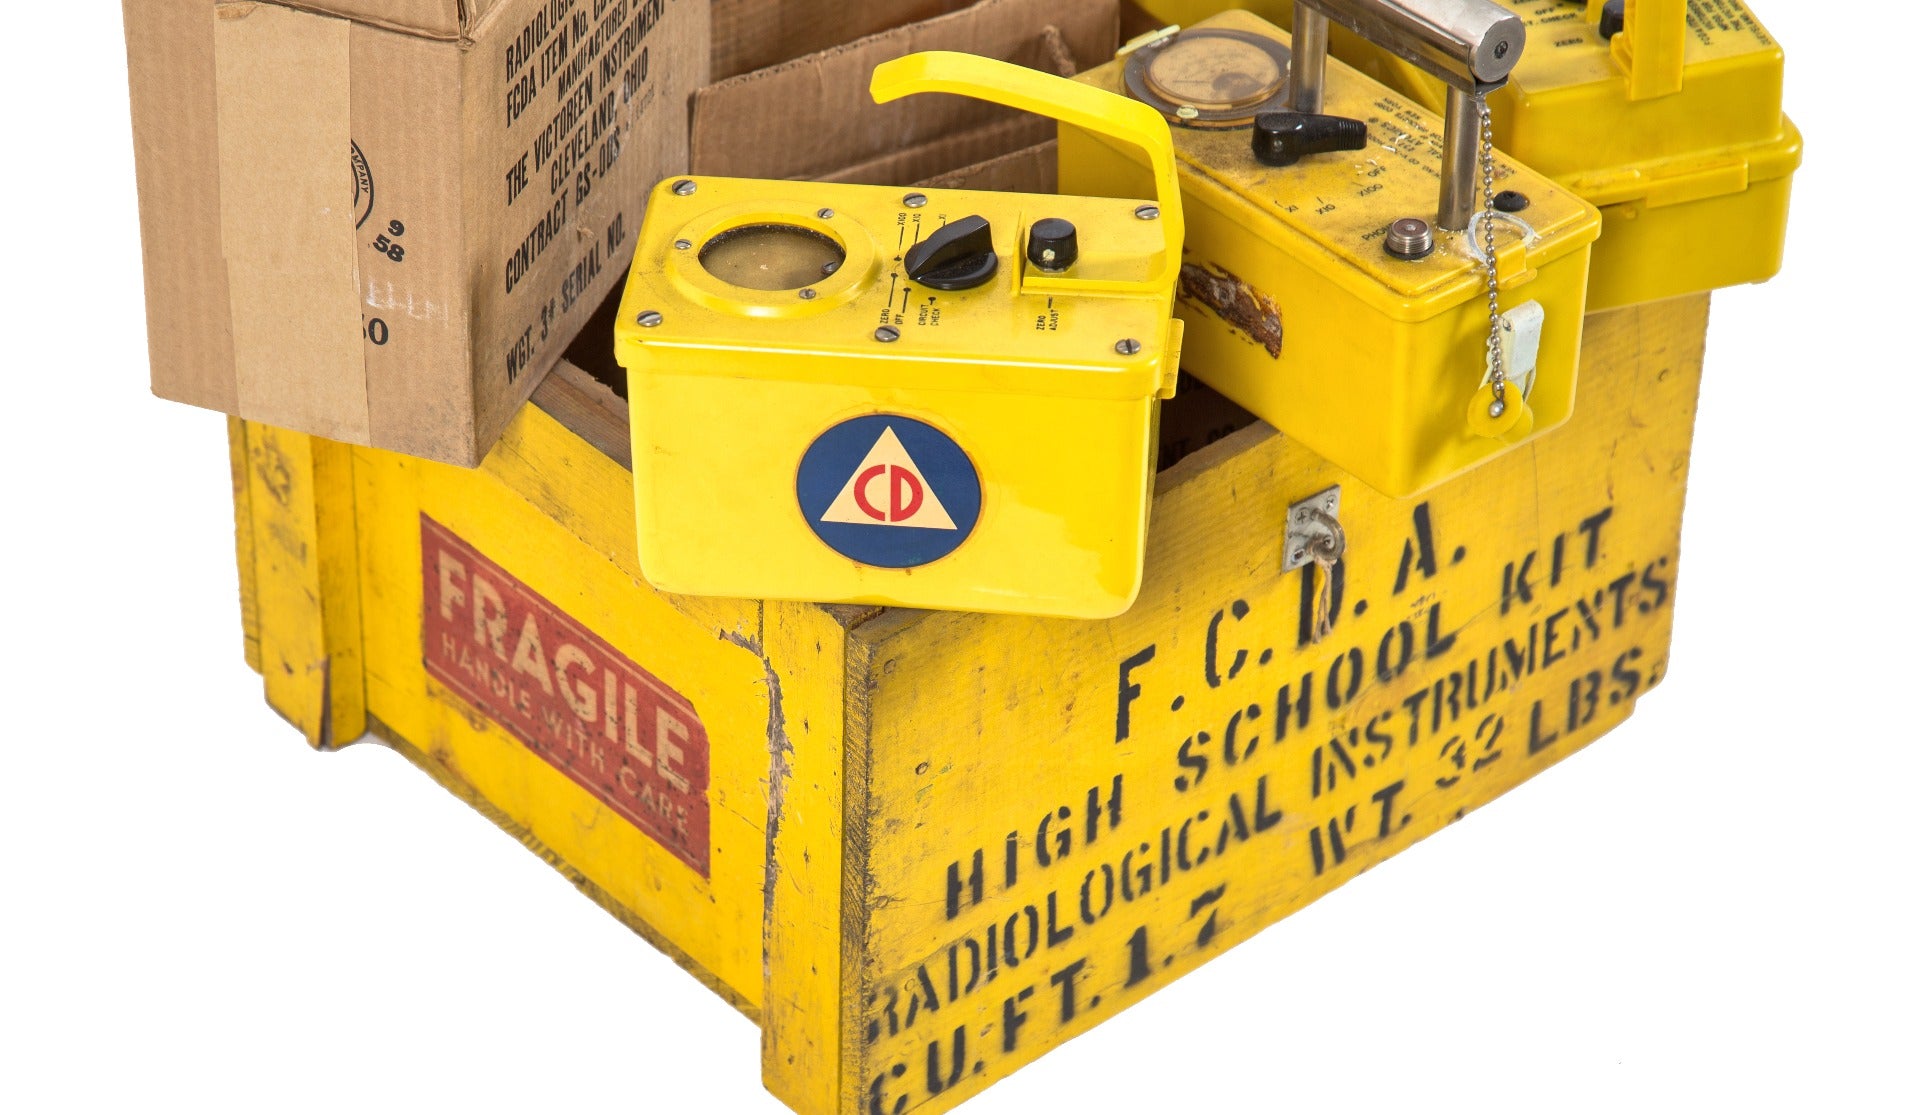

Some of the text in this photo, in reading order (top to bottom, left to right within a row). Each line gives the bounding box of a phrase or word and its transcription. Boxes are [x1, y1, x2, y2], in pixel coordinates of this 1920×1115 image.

[558, 0, 628, 102] MANUFACTURED
[507, 64, 537, 129] FCDA
[541, 23, 568, 89] ITEM
[506, 150, 529, 207] THE
[534, 71, 593, 173] VICTOREEN
[551, 90, 618, 196] CLEVELAND,
[624, 46, 649, 104] OHIO
[1357, 182, 1385, 198] X100
[1367, 164, 1387, 178] OFF
[388, 219, 405, 237] 9
[1314, 202, 1337, 216] X10
[373, 233, 406, 262] 58
[506, 187, 569, 294] CONTRACT
[362, 313, 389, 346] 0
[506, 325, 536, 385] WGT.
[562, 240, 602, 314] SERIAL
[880, 308, 890, 324] ZERO
[895, 313, 904, 325] OFF
[918, 303, 929, 326] CIRCUIT
[930, 307, 941, 326] CHECK
[1036, 314, 1047, 331] ZERO
[1049, 309, 1059, 331] ADJUST
[853, 463, 924, 523] CD
[437, 548, 691, 797] FRAGILE
[441, 632, 690, 835] HANDLE WITH CARE
[945, 505, 1614, 922] HIGH SCHOOL KIT
[866, 556, 1669, 1045] RADIOLOGICAL INSTRUMENTS
[1307, 779, 1412, 877] WT.
[1435, 712, 1505, 789] 32
